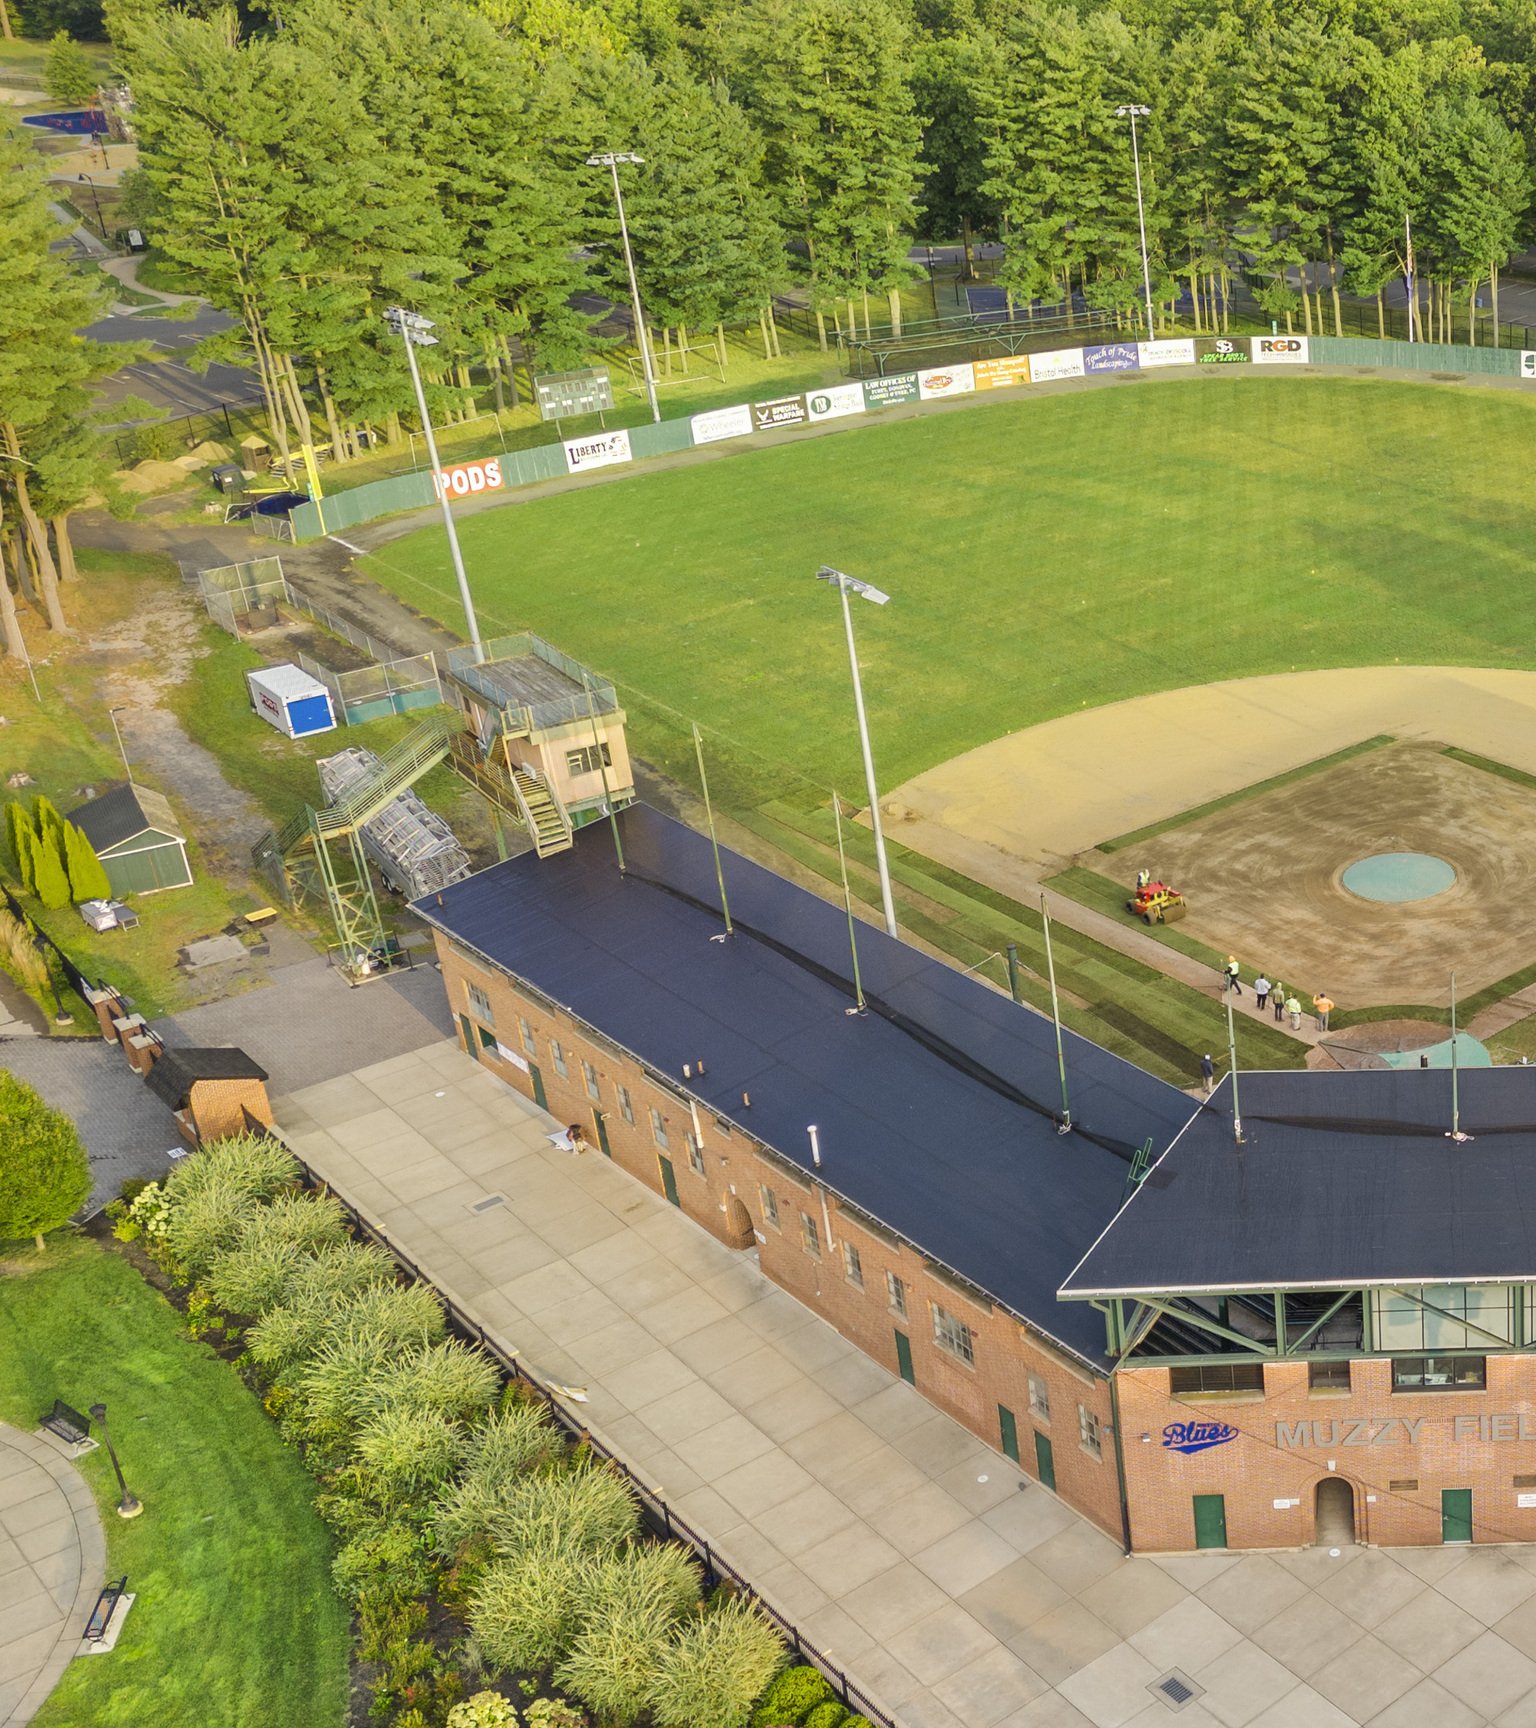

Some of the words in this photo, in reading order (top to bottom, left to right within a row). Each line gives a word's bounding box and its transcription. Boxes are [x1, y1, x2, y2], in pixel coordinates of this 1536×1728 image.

[1261, 340, 1301, 352] RGD
[1086, 347, 1107, 366] Touch
[1108, 347, 1115, 357] of
[1118, 347, 1137, 361] Pride
[1034, 368, 1056, 380] Bristol
[1058, 364, 1081, 376] Health
[865, 381, 879, 391] LAW
[879, 376, 905, 387] OFFICES
[906, 374, 917, 383] OF
[772, 403, 800, 416] SPECIAL
[773, 409, 805, 423] WARFARE
[569, 442, 607, 465] LIBERTY
[433, 462, 502, 498] PODS
[1163, 1421, 1235, 1447] Blues
[1276, 1417, 1427, 1449] MUZZY
